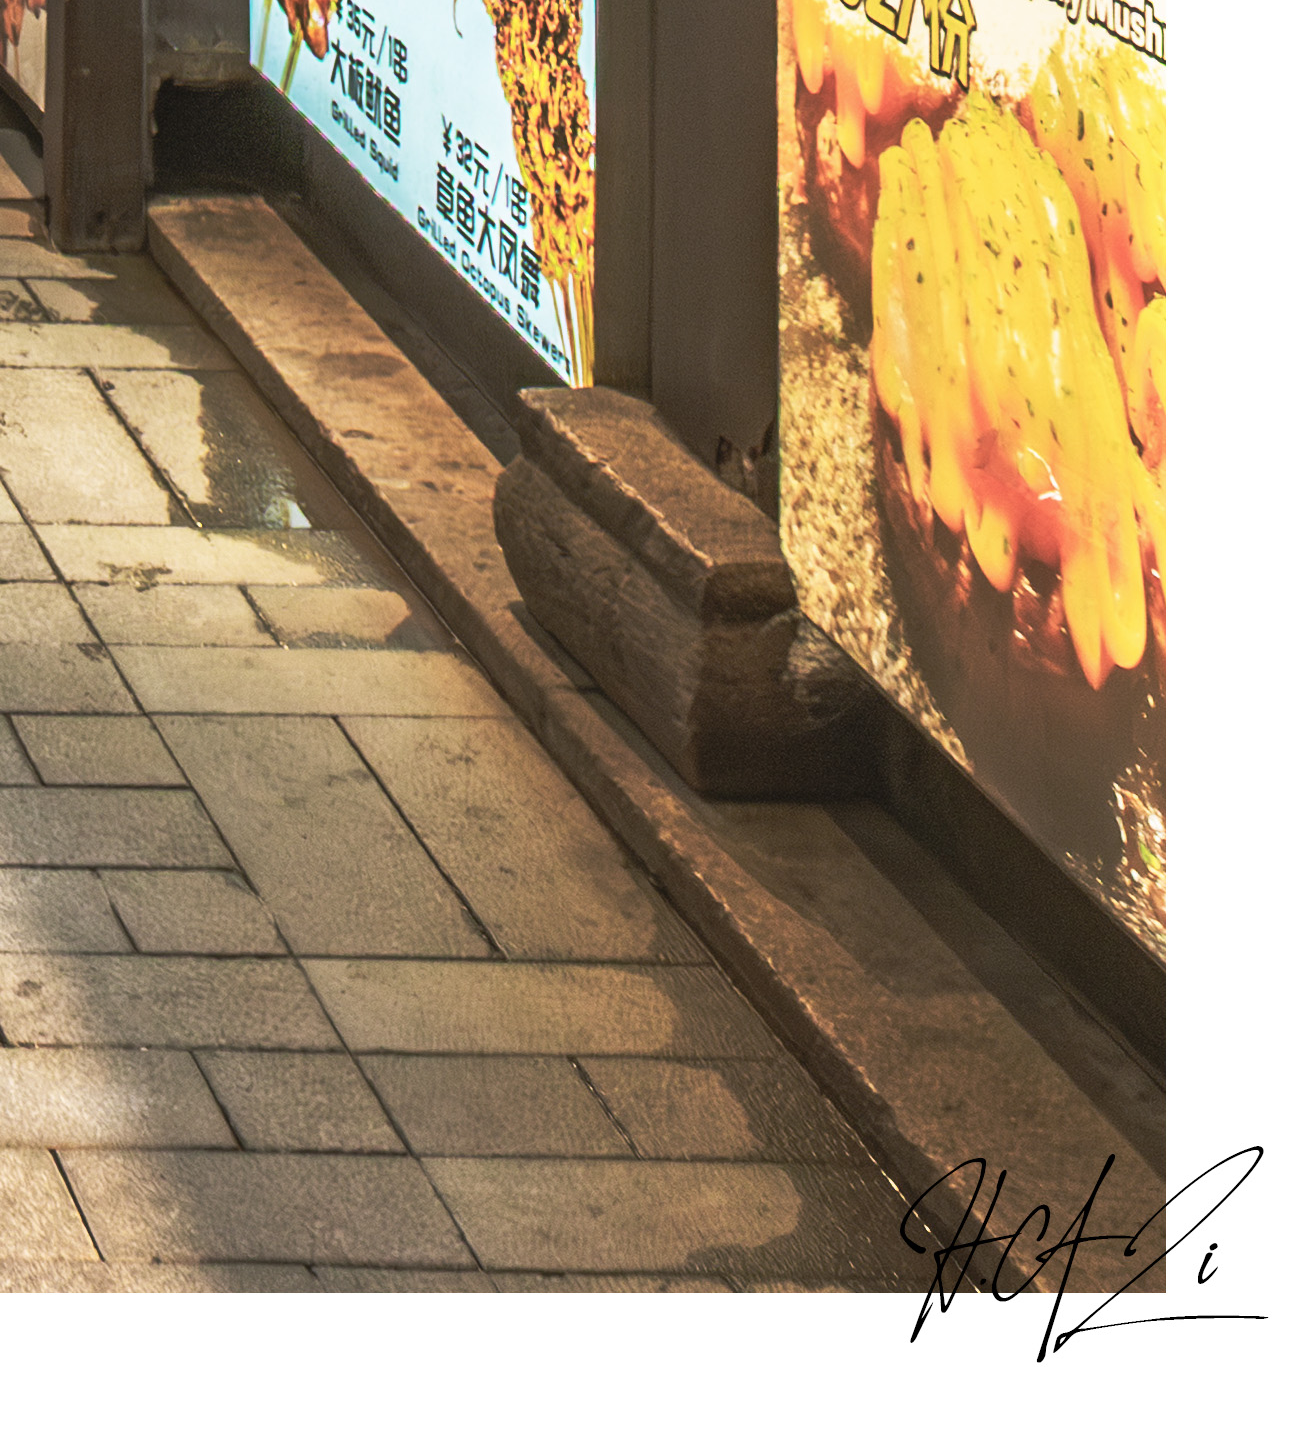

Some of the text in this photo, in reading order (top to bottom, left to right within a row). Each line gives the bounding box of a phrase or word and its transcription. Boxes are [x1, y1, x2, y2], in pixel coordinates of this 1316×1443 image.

[331, 37, 401, 148] 大板鱿鱼
[331, 99, 399, 183] Grilled Squid
[417, 205, 457, 261] Grilled
[461, 250, 510, 316] Octopus
